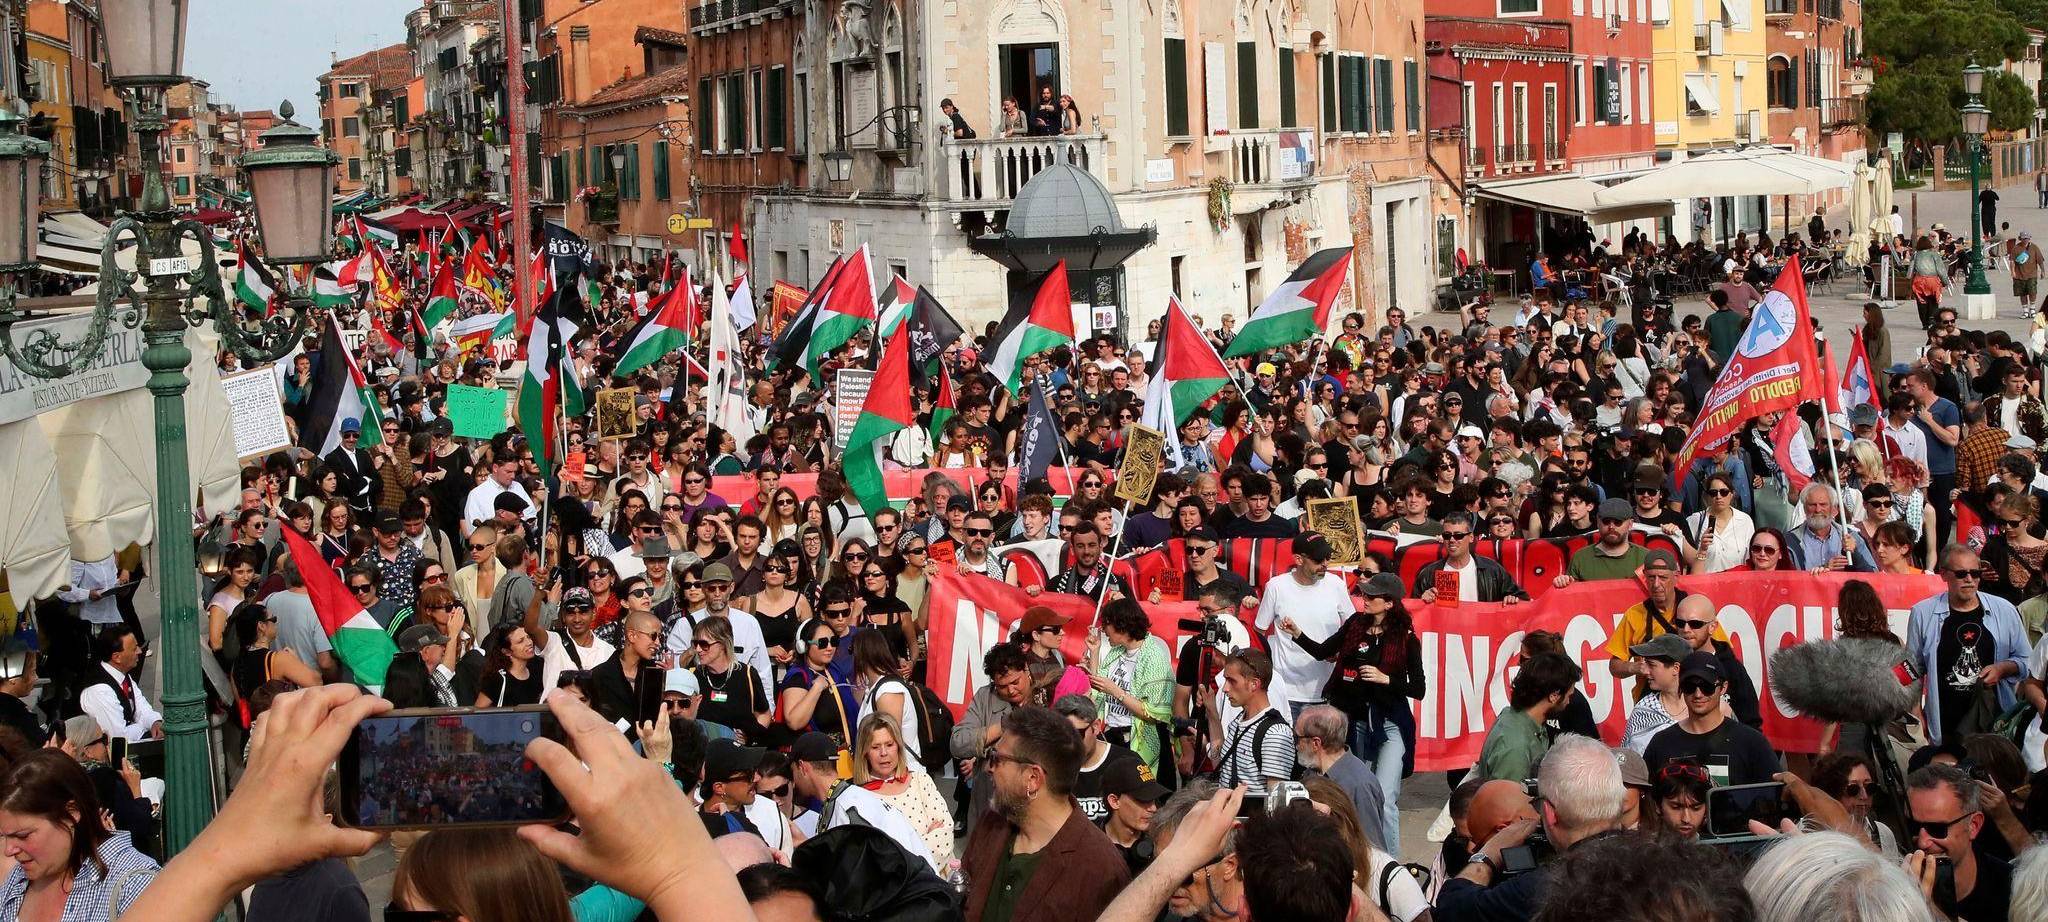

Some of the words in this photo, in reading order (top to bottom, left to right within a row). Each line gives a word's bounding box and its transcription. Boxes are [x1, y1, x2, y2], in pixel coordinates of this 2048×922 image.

[669, 219, 682, 228] PT
[156, 261, 167, 273] CS
[172, 259, 187, 271] AF15
[91, 330, 141, 370] ERLA
